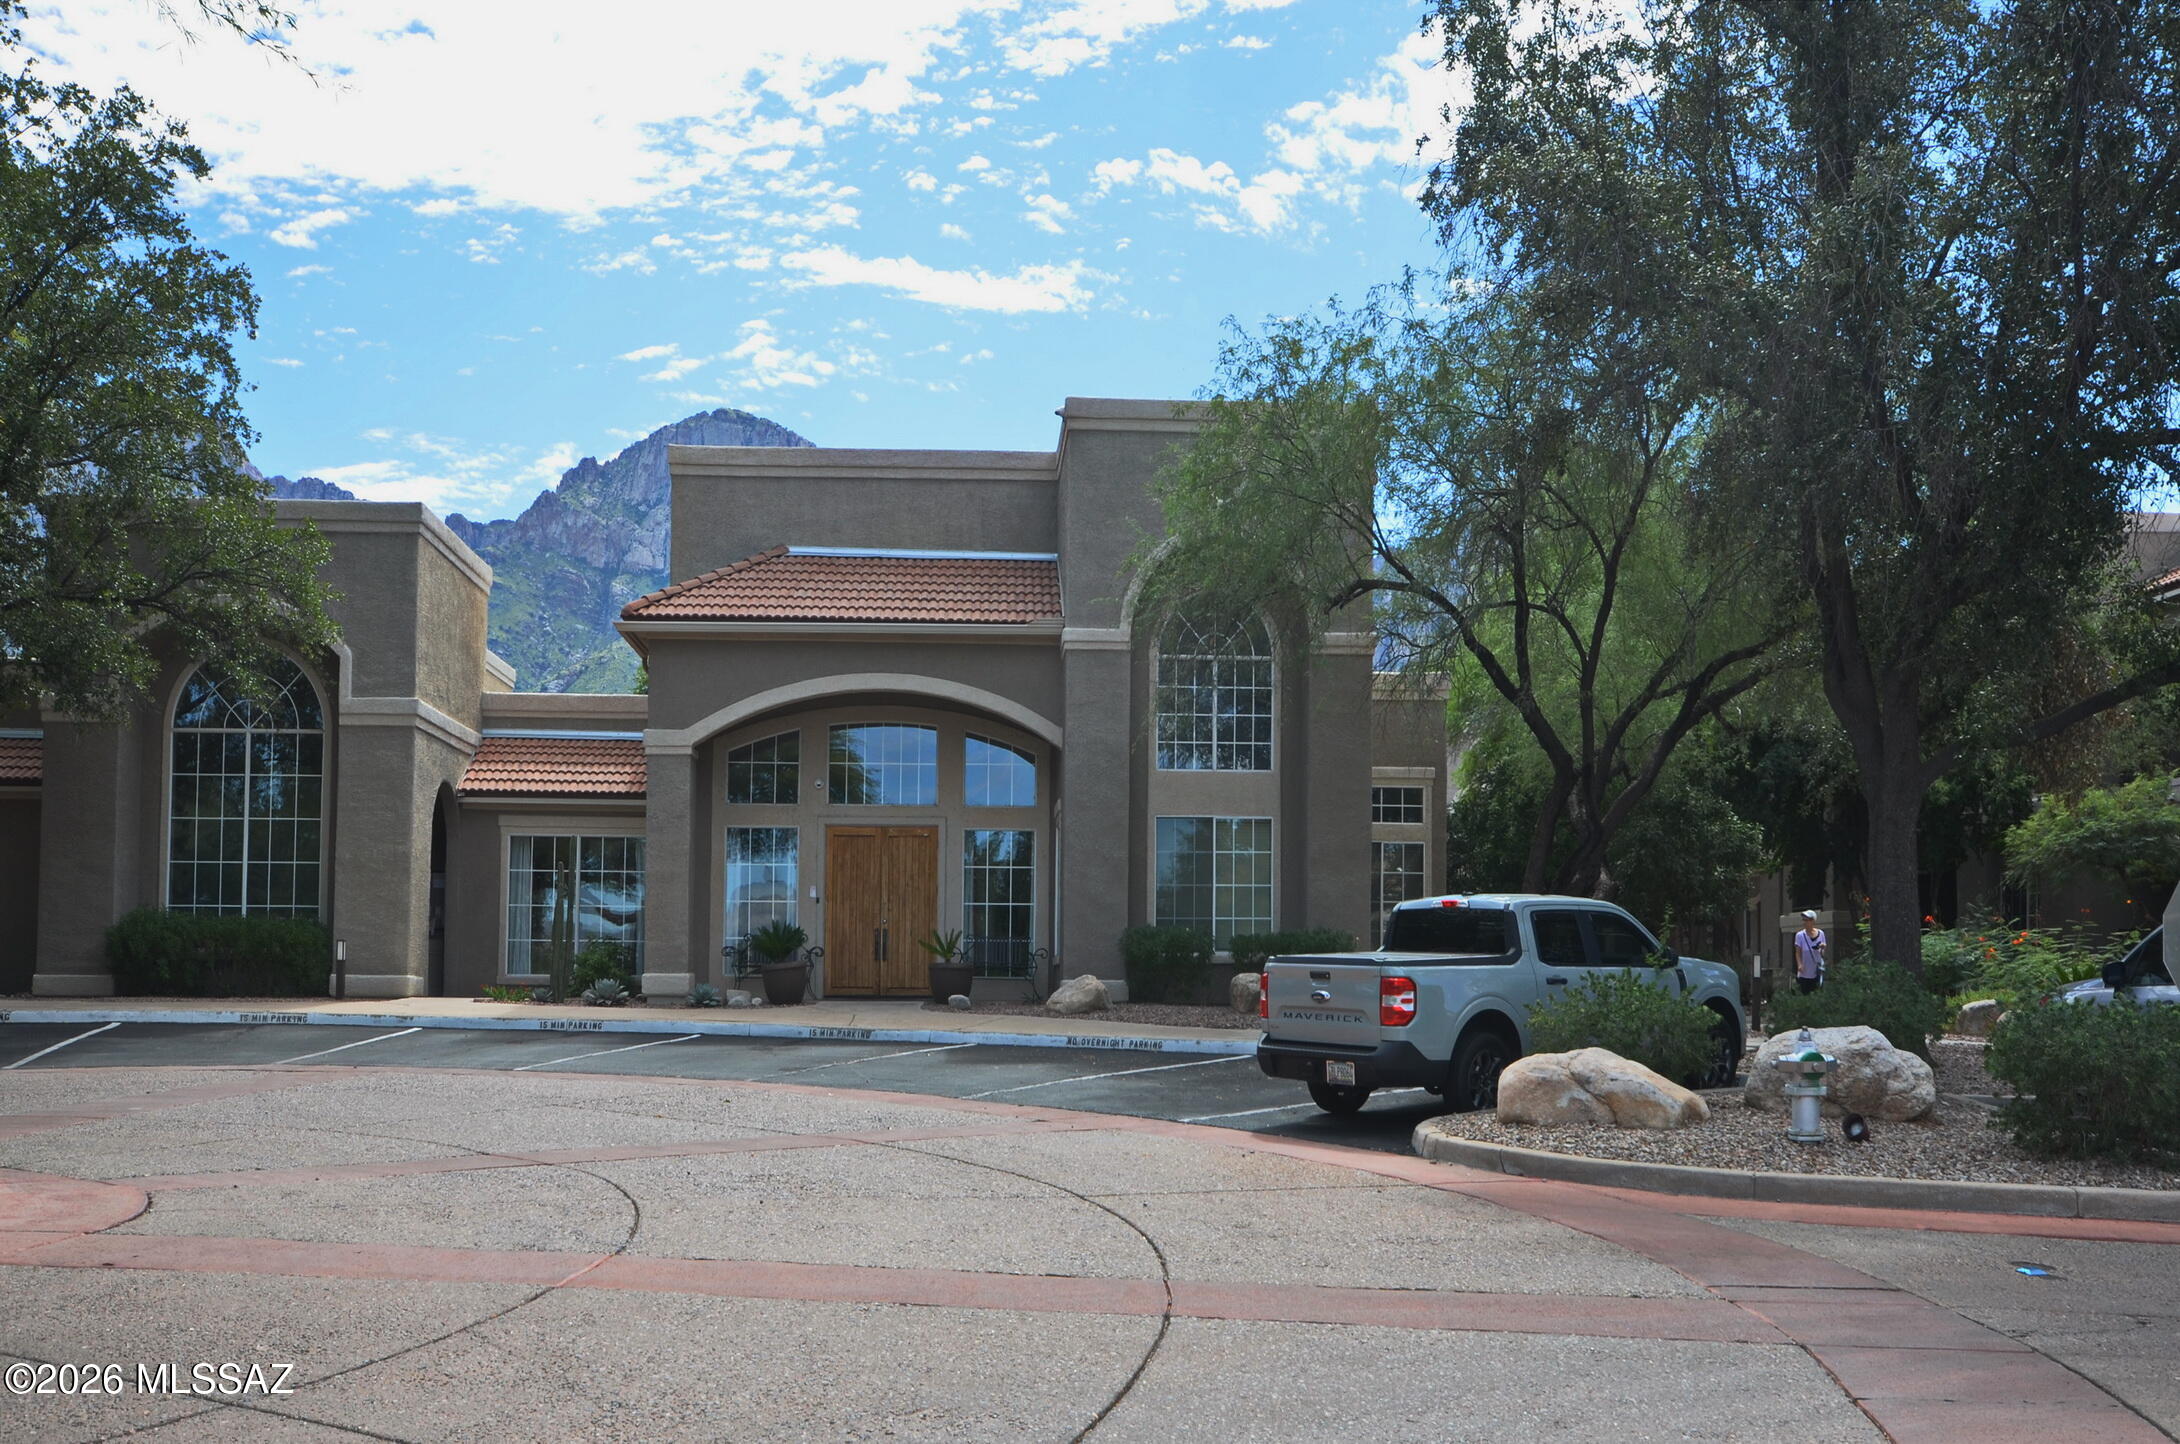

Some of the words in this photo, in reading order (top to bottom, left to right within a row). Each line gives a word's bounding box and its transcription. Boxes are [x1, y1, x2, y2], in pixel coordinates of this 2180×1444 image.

[240, 1014, 250, 1022] 15
[252, 1014, 268, 1023] MIN
[270, 1014, 308, 1024] PARKING
[1283, 1011, 1363, 1024] MAVERICK
[540, 1020, 549, 1029] 15
[550, 1021, 566, 1029] MIN
[568, 1021, 604, 1031] PARKING
[809, 1028, 817, 1037] 15
[820, 1029, 835, 1037] MIN
[837, 1029, 872, 1040] PARKING
[1066, 1036, 1077, 1046] NO
[1080, 1038, 1124, 1048] OVERNIGHT
[1128, 1039, 1163, 1050] PARKING
